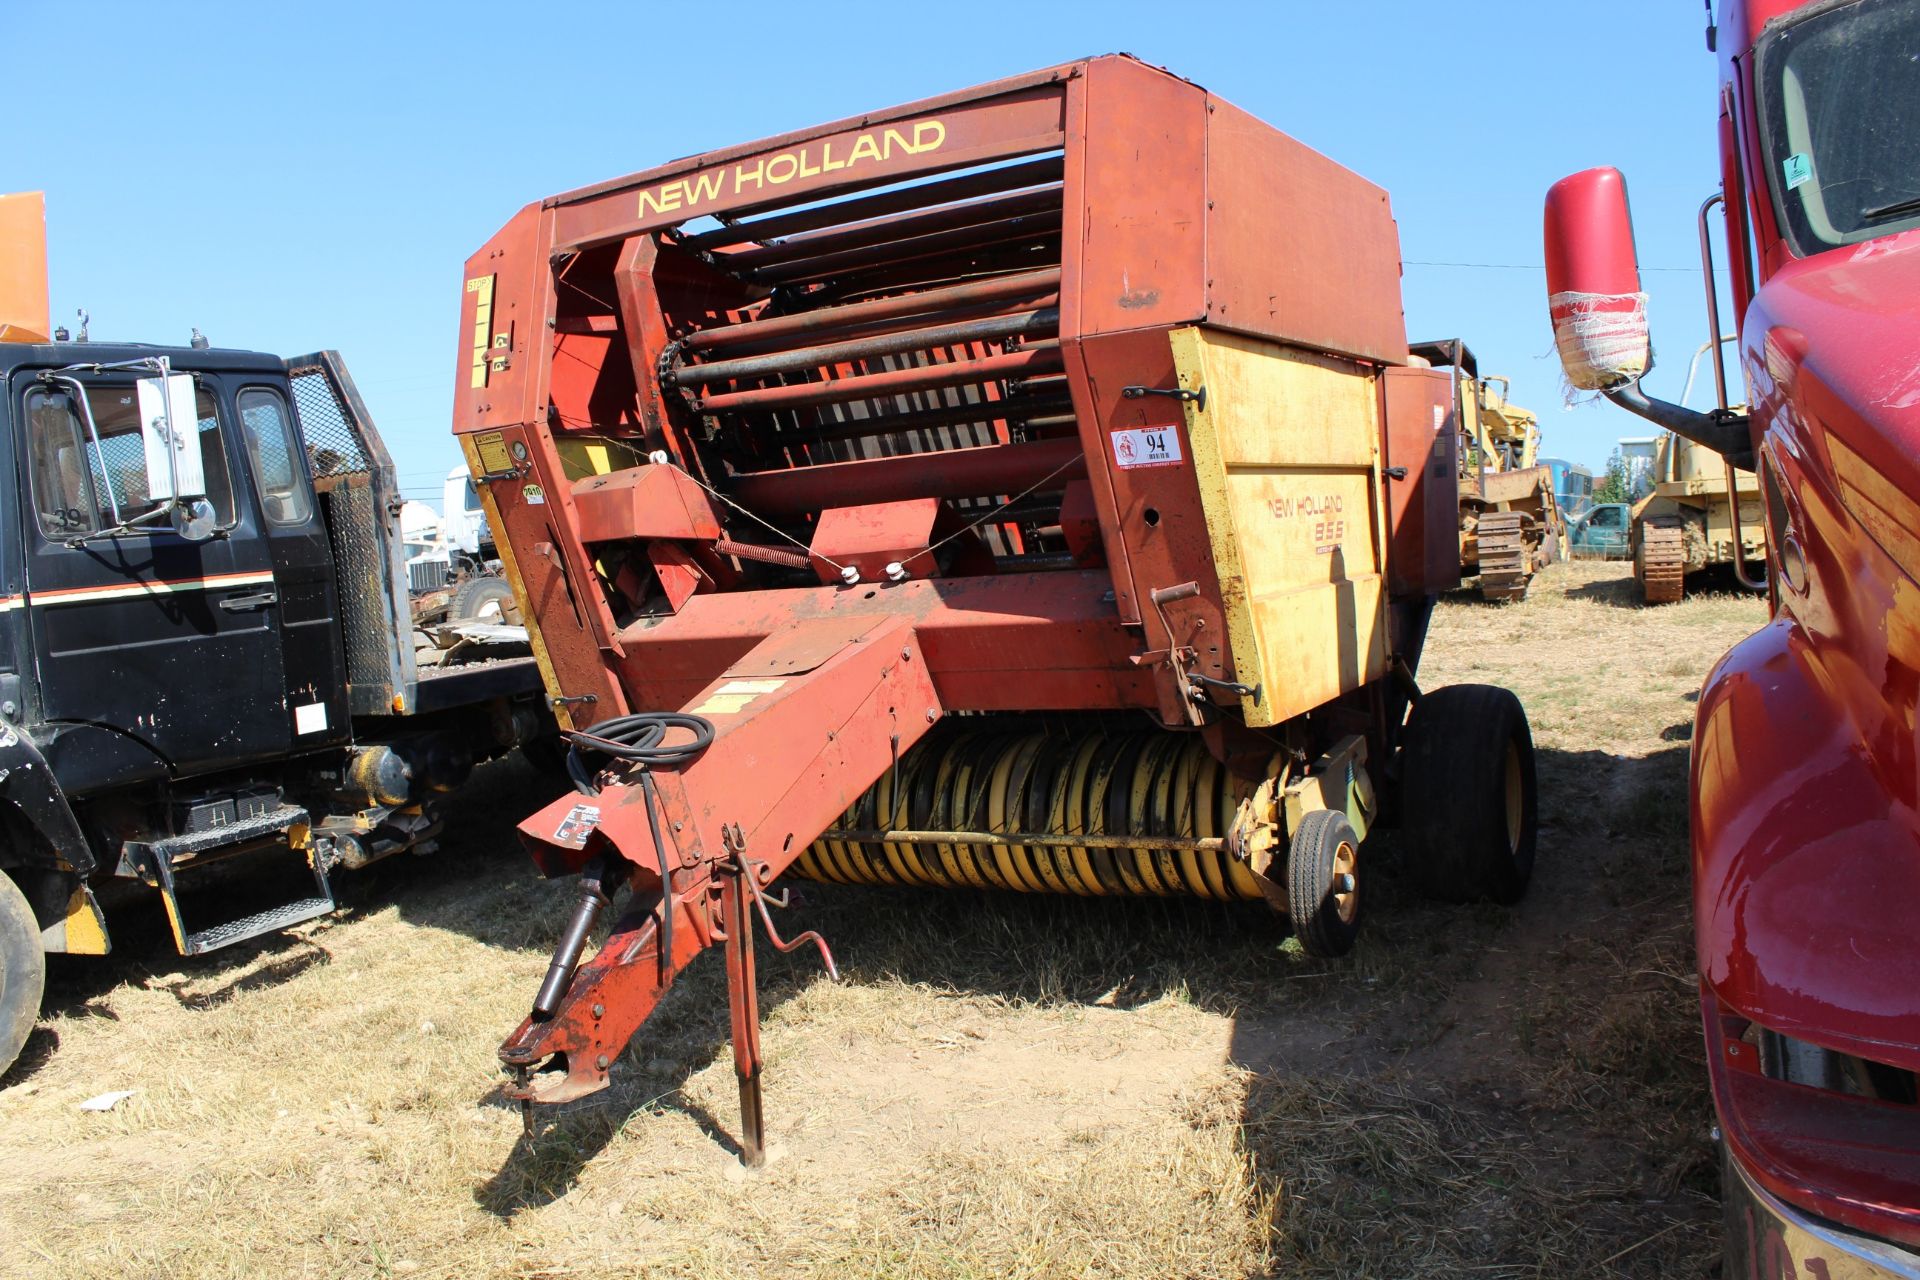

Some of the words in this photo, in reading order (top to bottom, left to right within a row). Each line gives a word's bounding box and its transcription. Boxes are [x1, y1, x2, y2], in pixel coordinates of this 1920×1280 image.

[638, 170, 726, 219] NEW
[735, 120, 946, 194] HOLLAND
[468, 278, 488, 291] STOP
[482, 433, 501, 441] CAUTION
[1146, 433, 1166, 453] 94
[1268, 497, 1294, 518] NEW
[1296, 495, 1343, 516] HOLLAND
[55, 508, 81, 527] 39
[1315, 520, 1344, 541] 855
